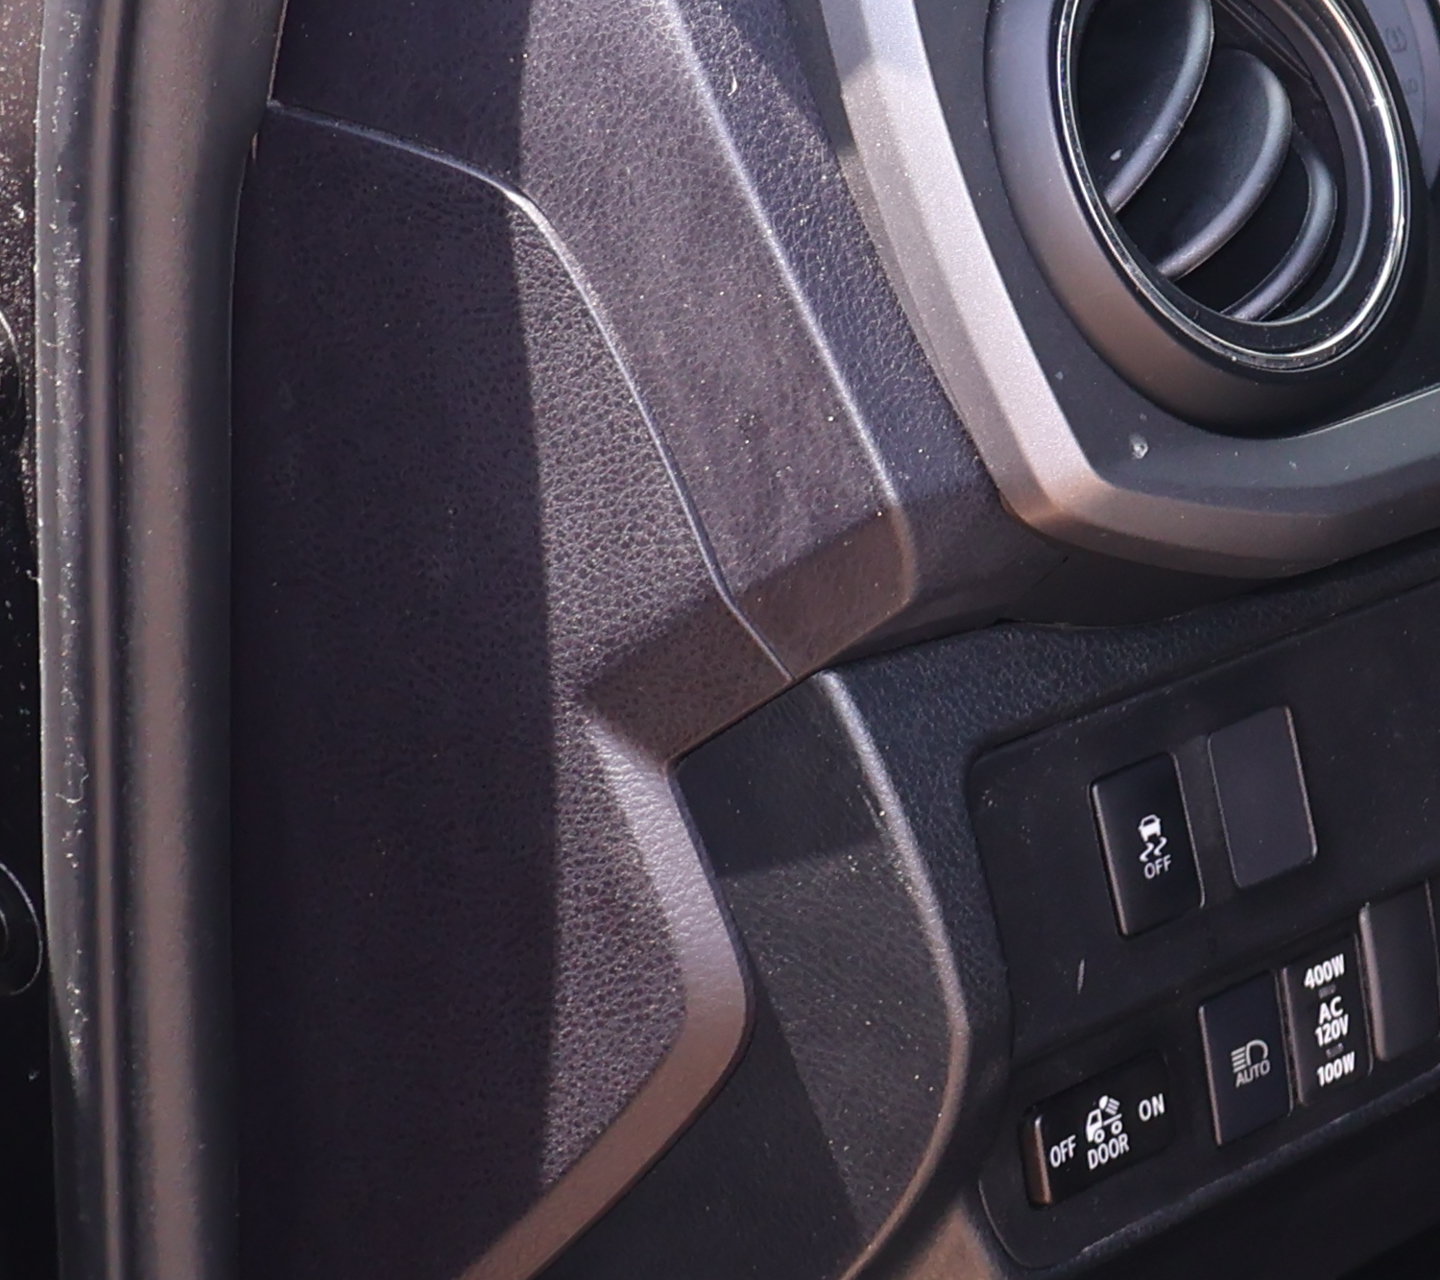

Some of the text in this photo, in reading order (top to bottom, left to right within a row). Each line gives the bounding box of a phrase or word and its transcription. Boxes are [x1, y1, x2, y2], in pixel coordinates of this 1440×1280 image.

[1143, 854, 1171, 879] OFF
[1304, 953, 1345, 990] 400W
[1318, 996, 1344, 1025] AC
[1314, 1013, 1349, 1047] 120V
[1235, 1059, 1271, 1088] AUTO
[1317, 1051, 1355, 1087] 100W
[1138, 1093, 1165, 1122] ON
[1050, 1133, 1076, 1168] OFF
[1087, 1133, 1129, 1170] DOOR
